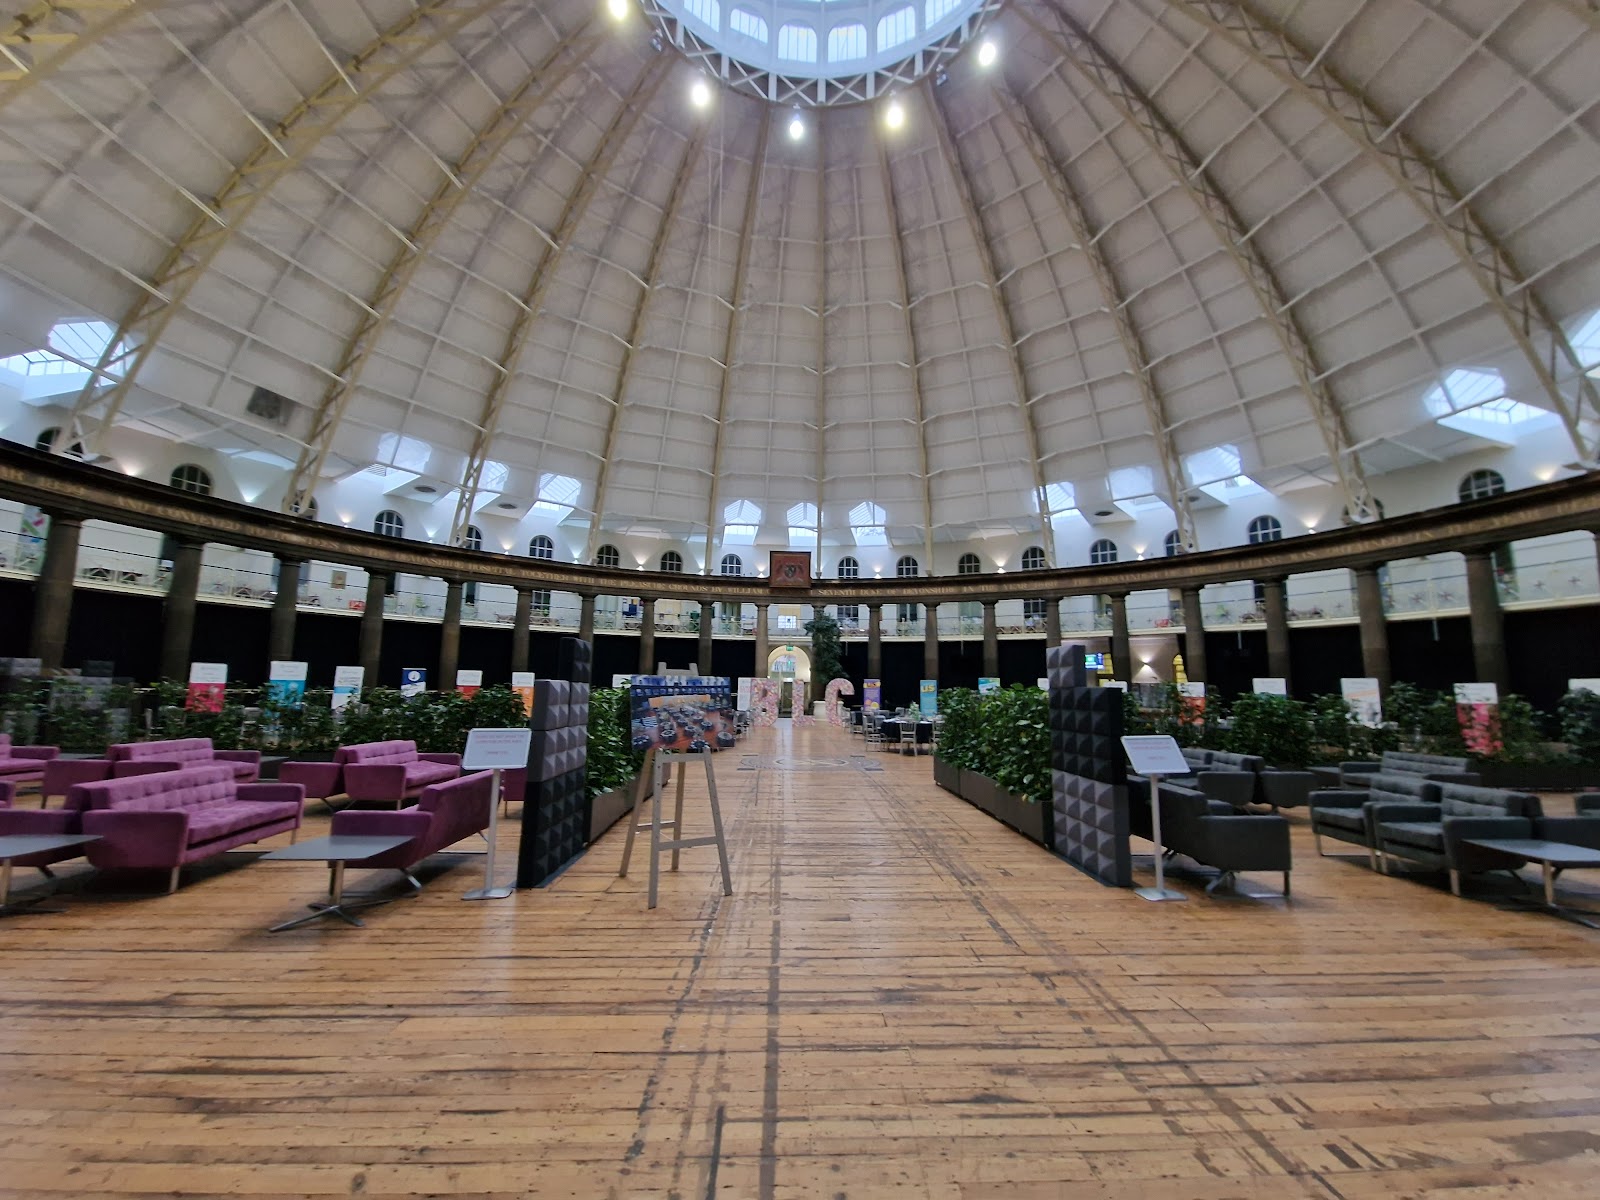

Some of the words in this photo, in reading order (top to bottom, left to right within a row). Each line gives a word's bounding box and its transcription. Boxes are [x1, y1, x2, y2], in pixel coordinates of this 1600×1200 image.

[395, 552, 463, 570] DEVONSHIRE
[468, 563, 513, 576] HOSPITAL
[521, 570, 568, 582] TOGETHER
[572, 575, 595, 584] WITH
[600, 578, 617, 586] THE
[620, 579, 664, 589] PLEASURE
[668, 583, 707, 592] GROUNDS
[727, 586, 763, 594] WILLIAM
[902, 586, 954, 594] DEVONSHIRE
[1003, 582, 1027, 590] YEAR
